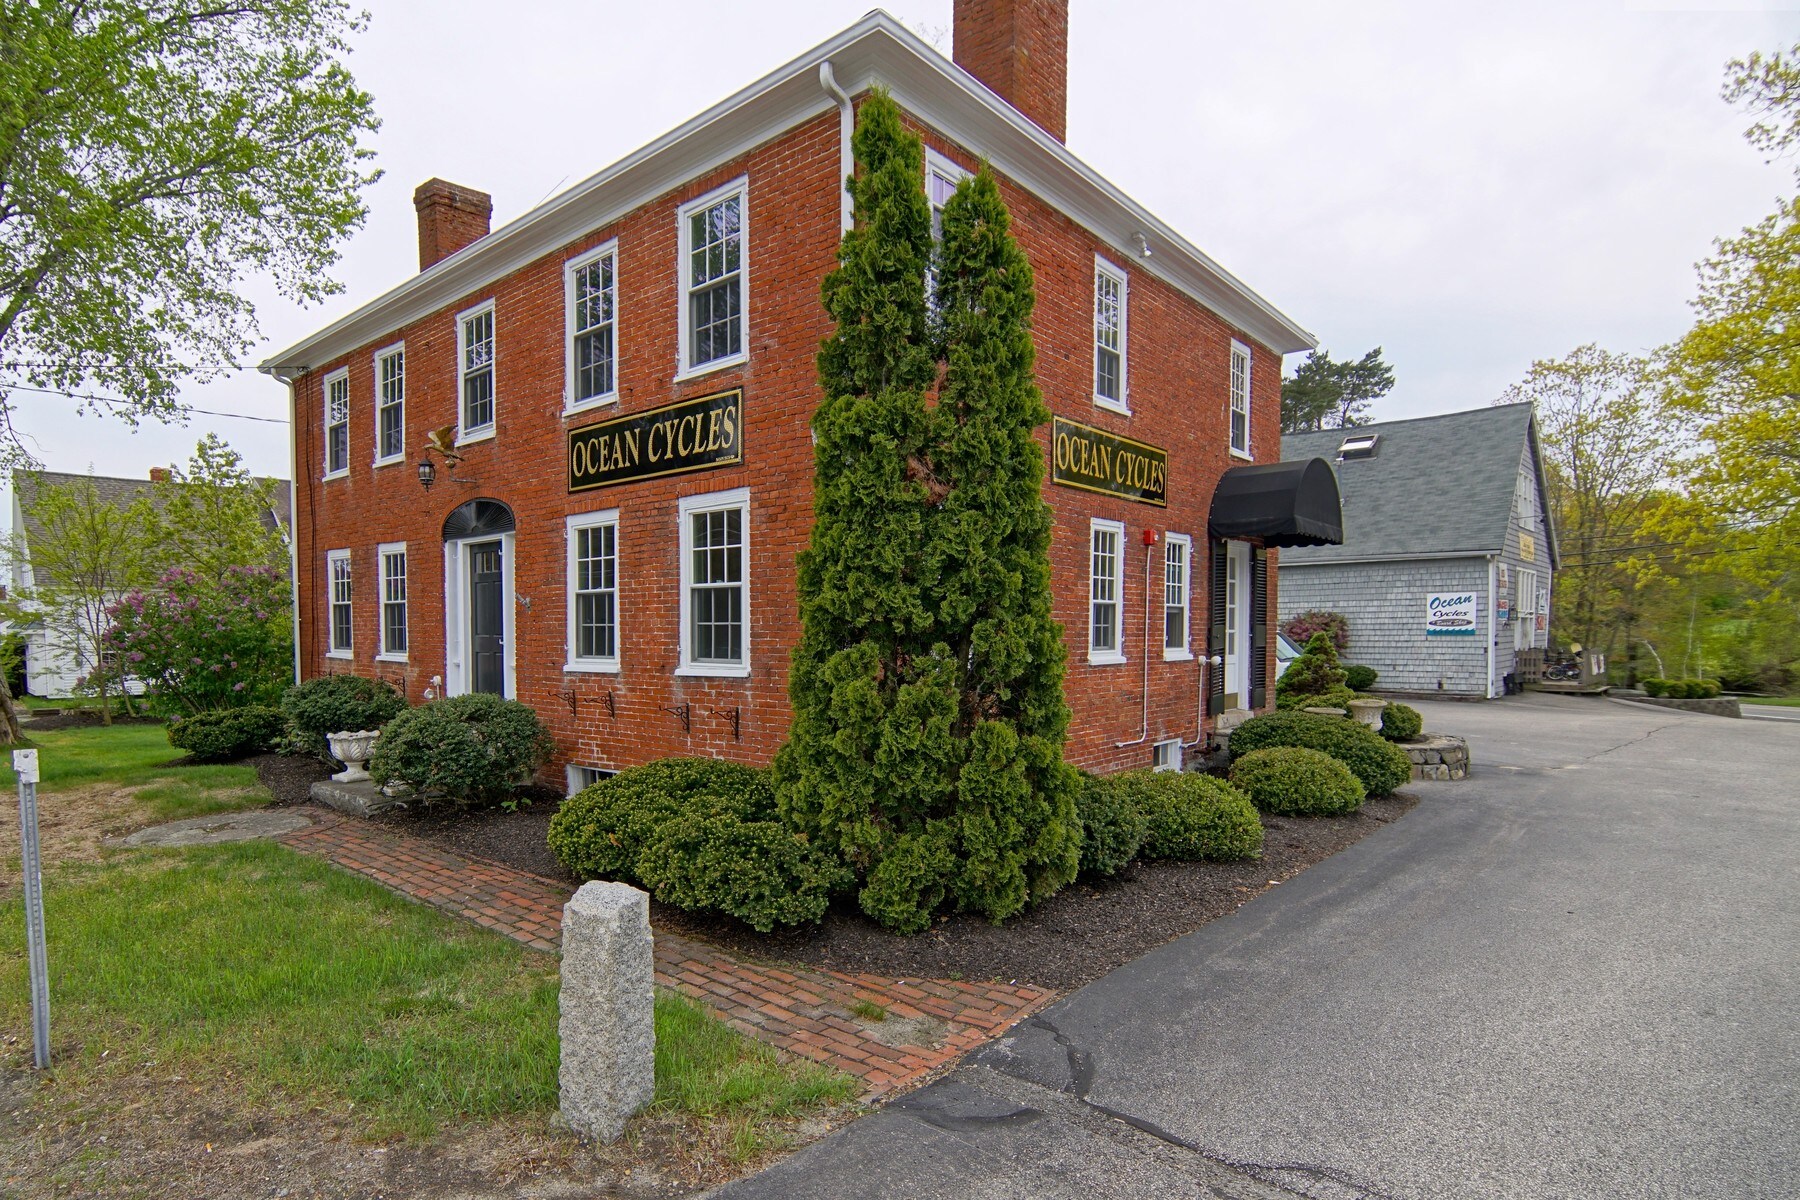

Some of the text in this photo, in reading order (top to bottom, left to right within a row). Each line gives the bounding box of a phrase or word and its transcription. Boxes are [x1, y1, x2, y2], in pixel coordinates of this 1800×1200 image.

[573, 406, 736, 477] OCEAN CYCLES
[1057, 433, 1165, 493] OCEAN CYCLES
[1429, 595, 1473, 610] Ocean
[1433, 610, 1469, 618] Cycles
